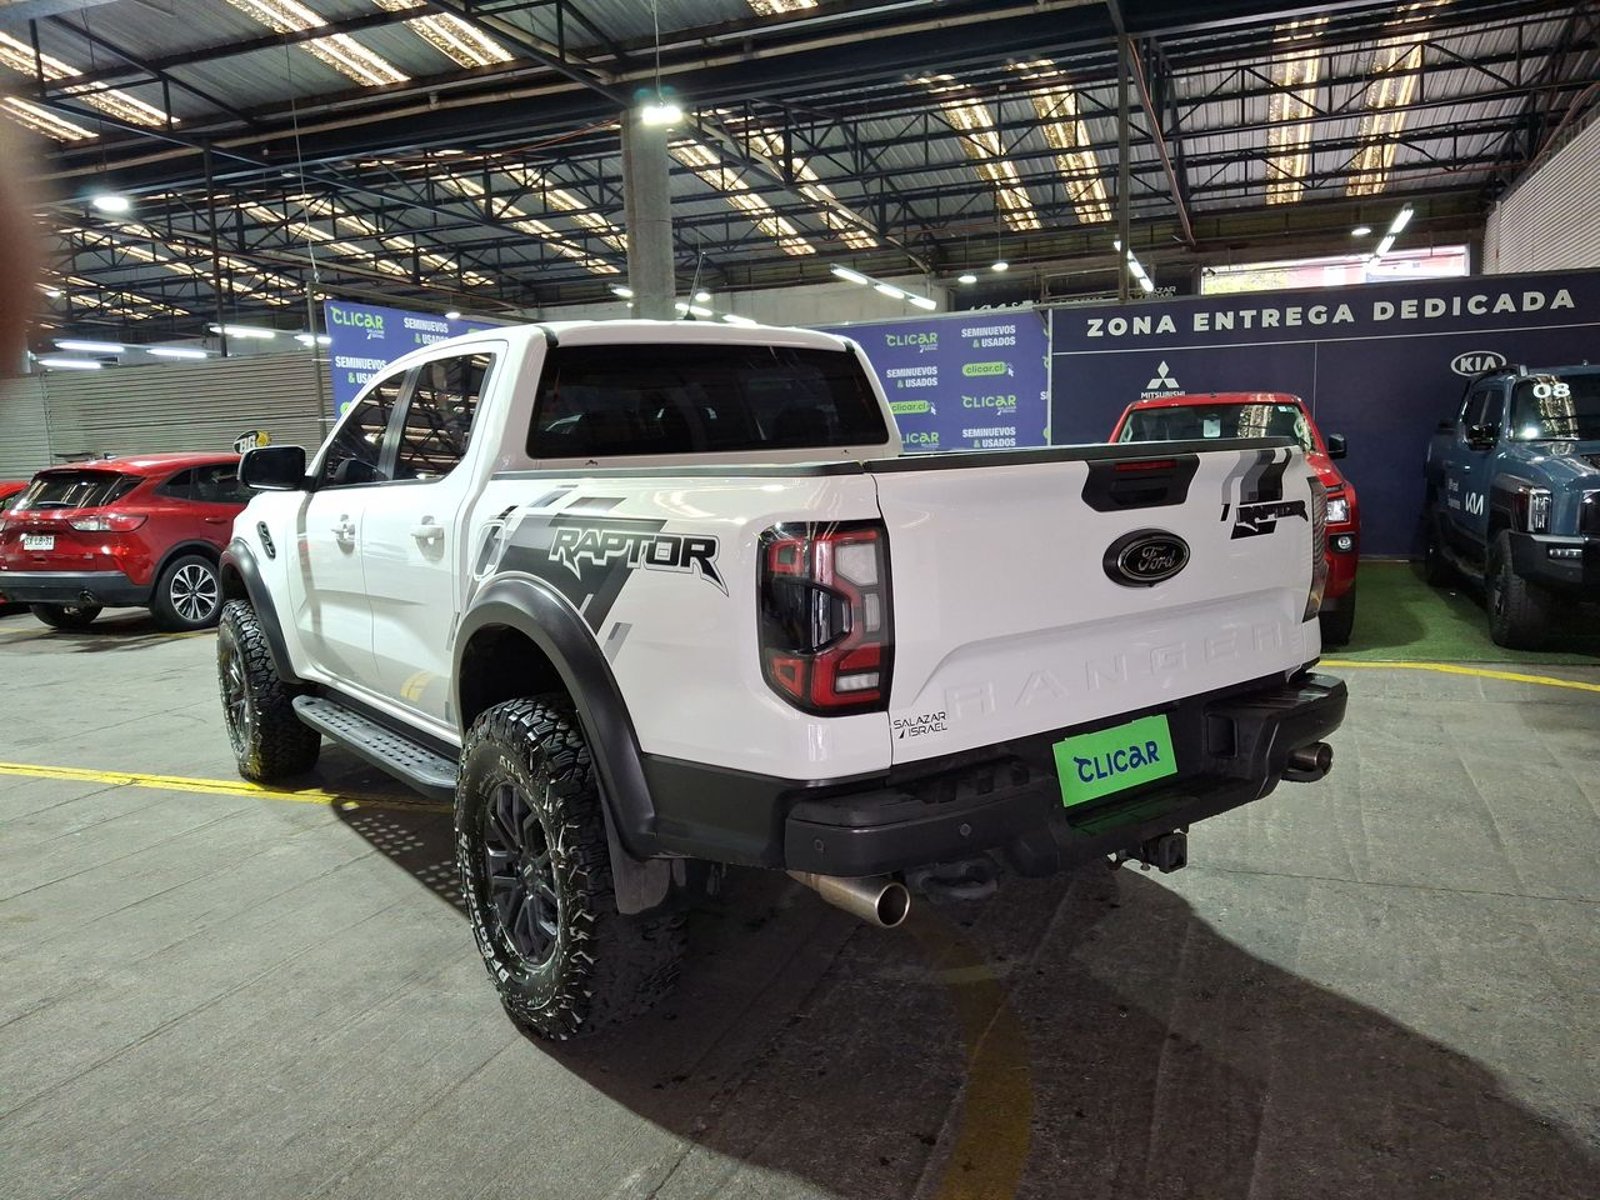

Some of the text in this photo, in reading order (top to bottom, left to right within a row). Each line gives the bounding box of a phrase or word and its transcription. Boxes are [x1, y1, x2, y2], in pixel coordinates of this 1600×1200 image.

[1087, 288, 1576, 338] ZONA ENTREGA DEDICADA
[403, 317, 449, 333] SEMINUEVOS
[961, 325, 1016, 338] SEMINUEVOS
[981, 336, 1016, 347] USADOS
[335, 356, 387, 370] SEMINUEVOS
[965, 363, 1003, 374] clicar.cl
[1460, 356, 1497, 372] KIA
[886, 366, 938, 378] SEMINUEVOS
[905, 377, 938, 388] USADOS
[1140, 391, 1186, 400] MITSUBISHI
[1533, 383, 1571, 398] 08
[891, 402, 926, 412] clicar.cl
[962, 427, 1016, 438] SEMINUEVOS
[981, 438, 1016, 448] USADOS
[549, 526, 730, 597] RAPTOR
[1137, 546, 1176, 572] Ford
[943, 621, 1285, 718] RANGER
[893, 711, 947, 730] SALAZAR
[908, 722, 948, 737] ISRAEL
